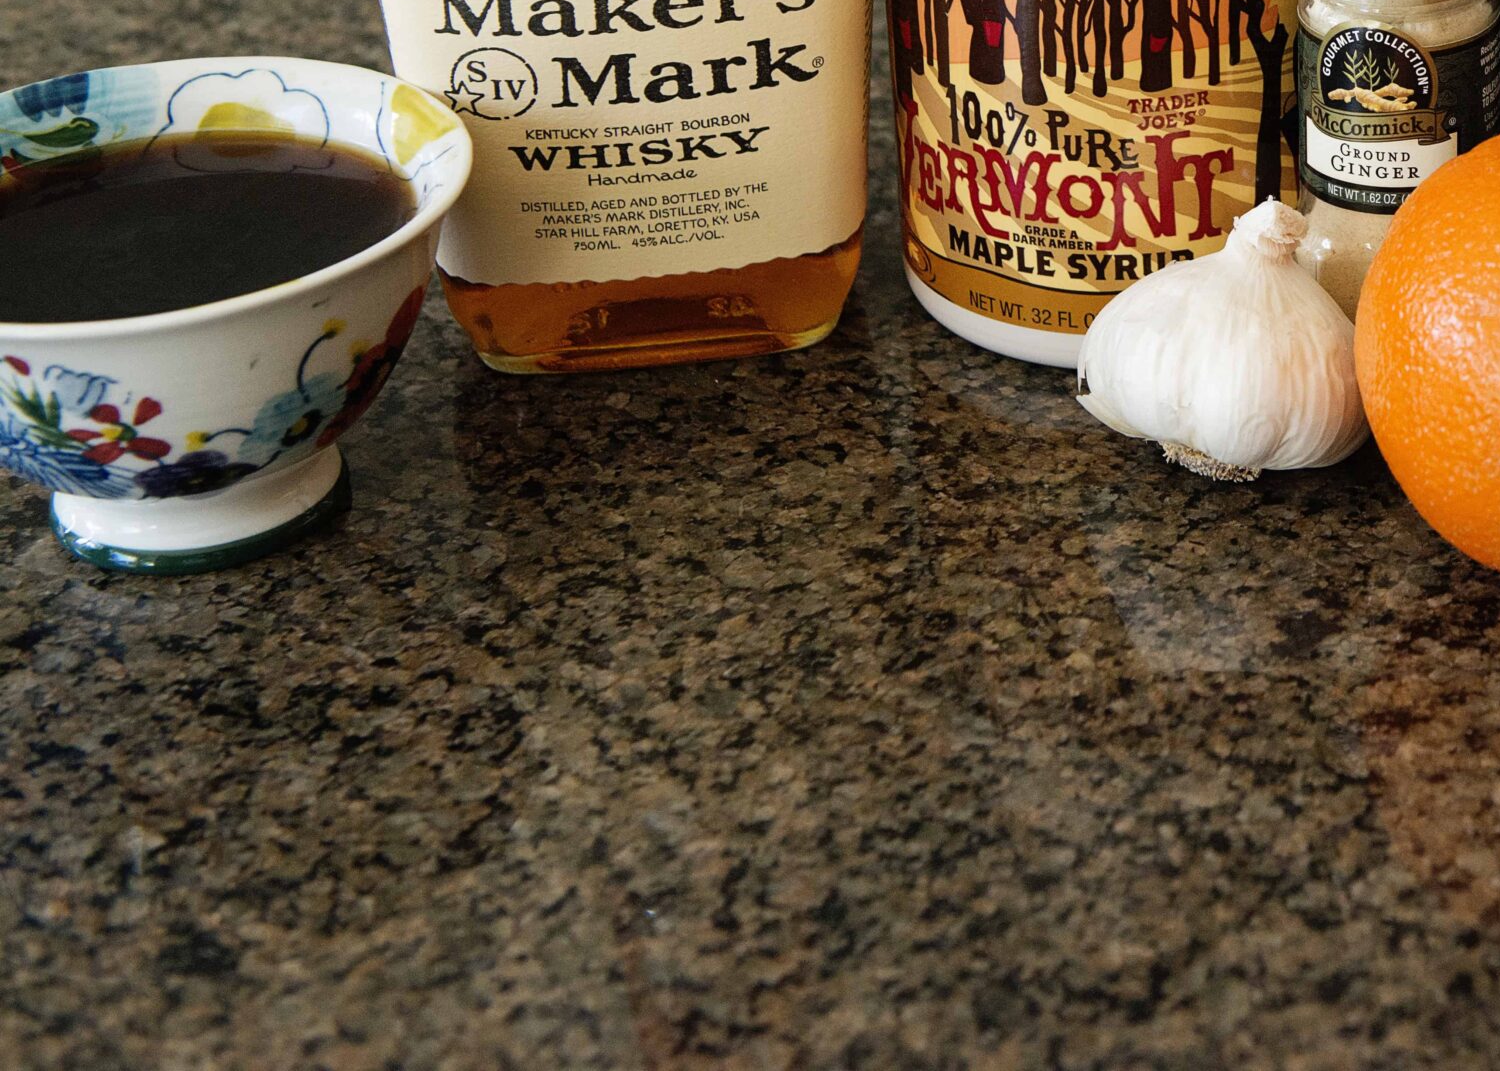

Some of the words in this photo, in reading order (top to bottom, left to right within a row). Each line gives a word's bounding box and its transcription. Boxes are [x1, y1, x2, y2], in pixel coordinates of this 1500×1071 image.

[1322, 30, 1360, 77] GOURMET
[552, 38, 820, 109] Mark
[1126, 90, 1211, 114] TRADER
[525, 128, 598, 140] KENTUCKY
[604, 122, 674, 138] STRAIGHT
[681, 113, 750, 131] BOURBON
[946, 83, 1037, 156] 100%
[1137, 110, 1198, 130] JOE'S
[1313, 108, 1426, 136] McCormick
[508, 126, 770, 171] WHISKY
[1340, 143, 1410, 162] GROUND
[588, 168, 698, 186] Handmade
[1331, 155, 1420, 179] GINGER
[521, 201, 588, 213] DISTILLED,
[591, 199, 626, 210] AGED
[630, 196, 657, 208] AND
[662, 189, 720, 205] BOTTLED
[725, 186, 740, 198] BY
[744, 182, 769, 194] THE
[1327, 182, 1343, 197] NET
[1345, 188, 1359, 200] WT
[1361, 191, 1381, 204] 1.62
[1383, 193, 1397, 204] OZ
[535, 228, 568, 239] STAR
[571, 226, 600, 238] HILL
[603, 224, 644, 237] FARM,
[648, 217, 709, 234] LORETTO,
[733, 211, 760, 223] USA
[542, 214, 601, 225] MAKER'S
[606, 211, 645, 222] MARK
[650, 203, 722, 220] DISTILLERY,
[725, 199, 750, 211] INC.
[1013, 233, 1046, 247] DARK
[1048, 238, 1094, 251] AMBER
[1025, 225, 1066, 239] GRADE
[1069, 230, 1079, 240] A
[949, 224, 1055, 277] MAPLE
[969, 289, 996, 314] NET
[1000, 299, 1026, 323] WT.
[1031, 305, 1052, 325] 32
[1057, 310, 1079, 329] FL
